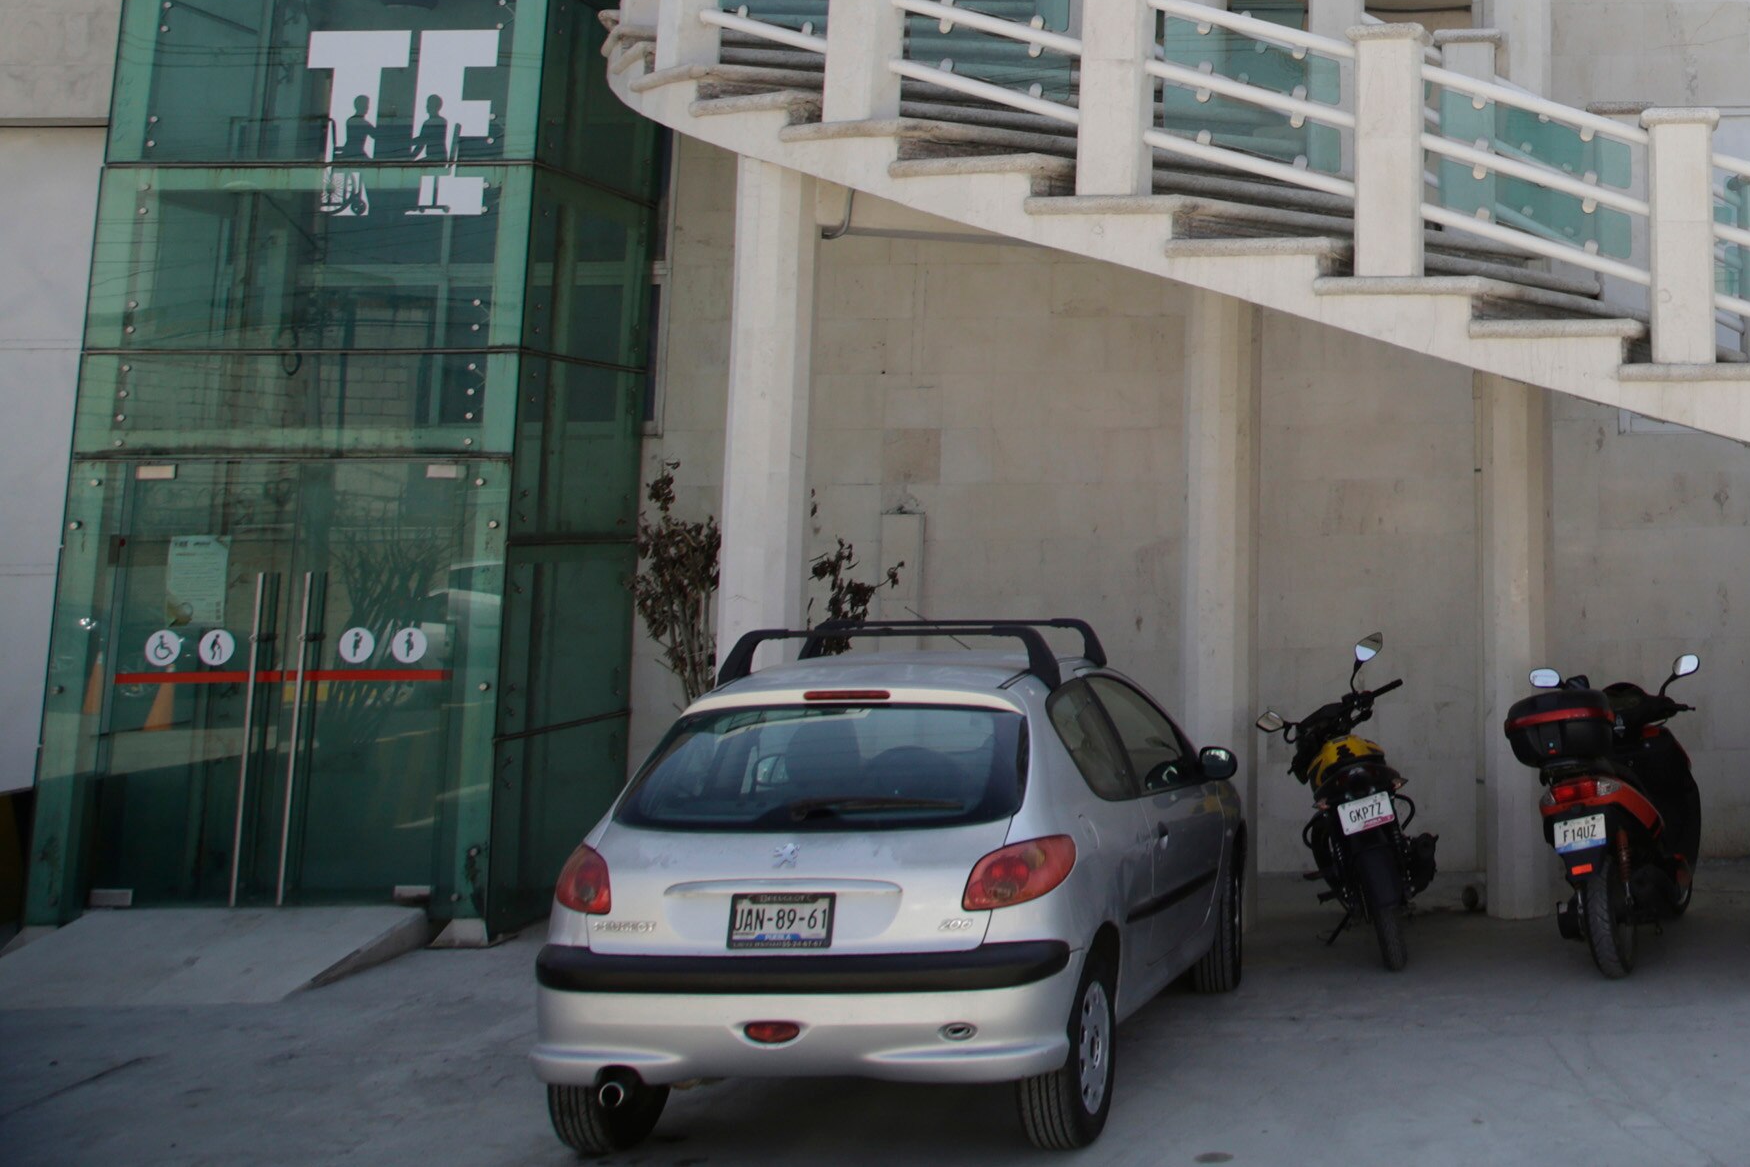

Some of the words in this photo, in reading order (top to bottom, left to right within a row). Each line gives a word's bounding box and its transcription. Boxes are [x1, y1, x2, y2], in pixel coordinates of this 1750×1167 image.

[306, 29, 500, 216] TE
[1349, 802, 1384, 823] GKP7Z
[1563, 824, 1597, 842] F14UZ
